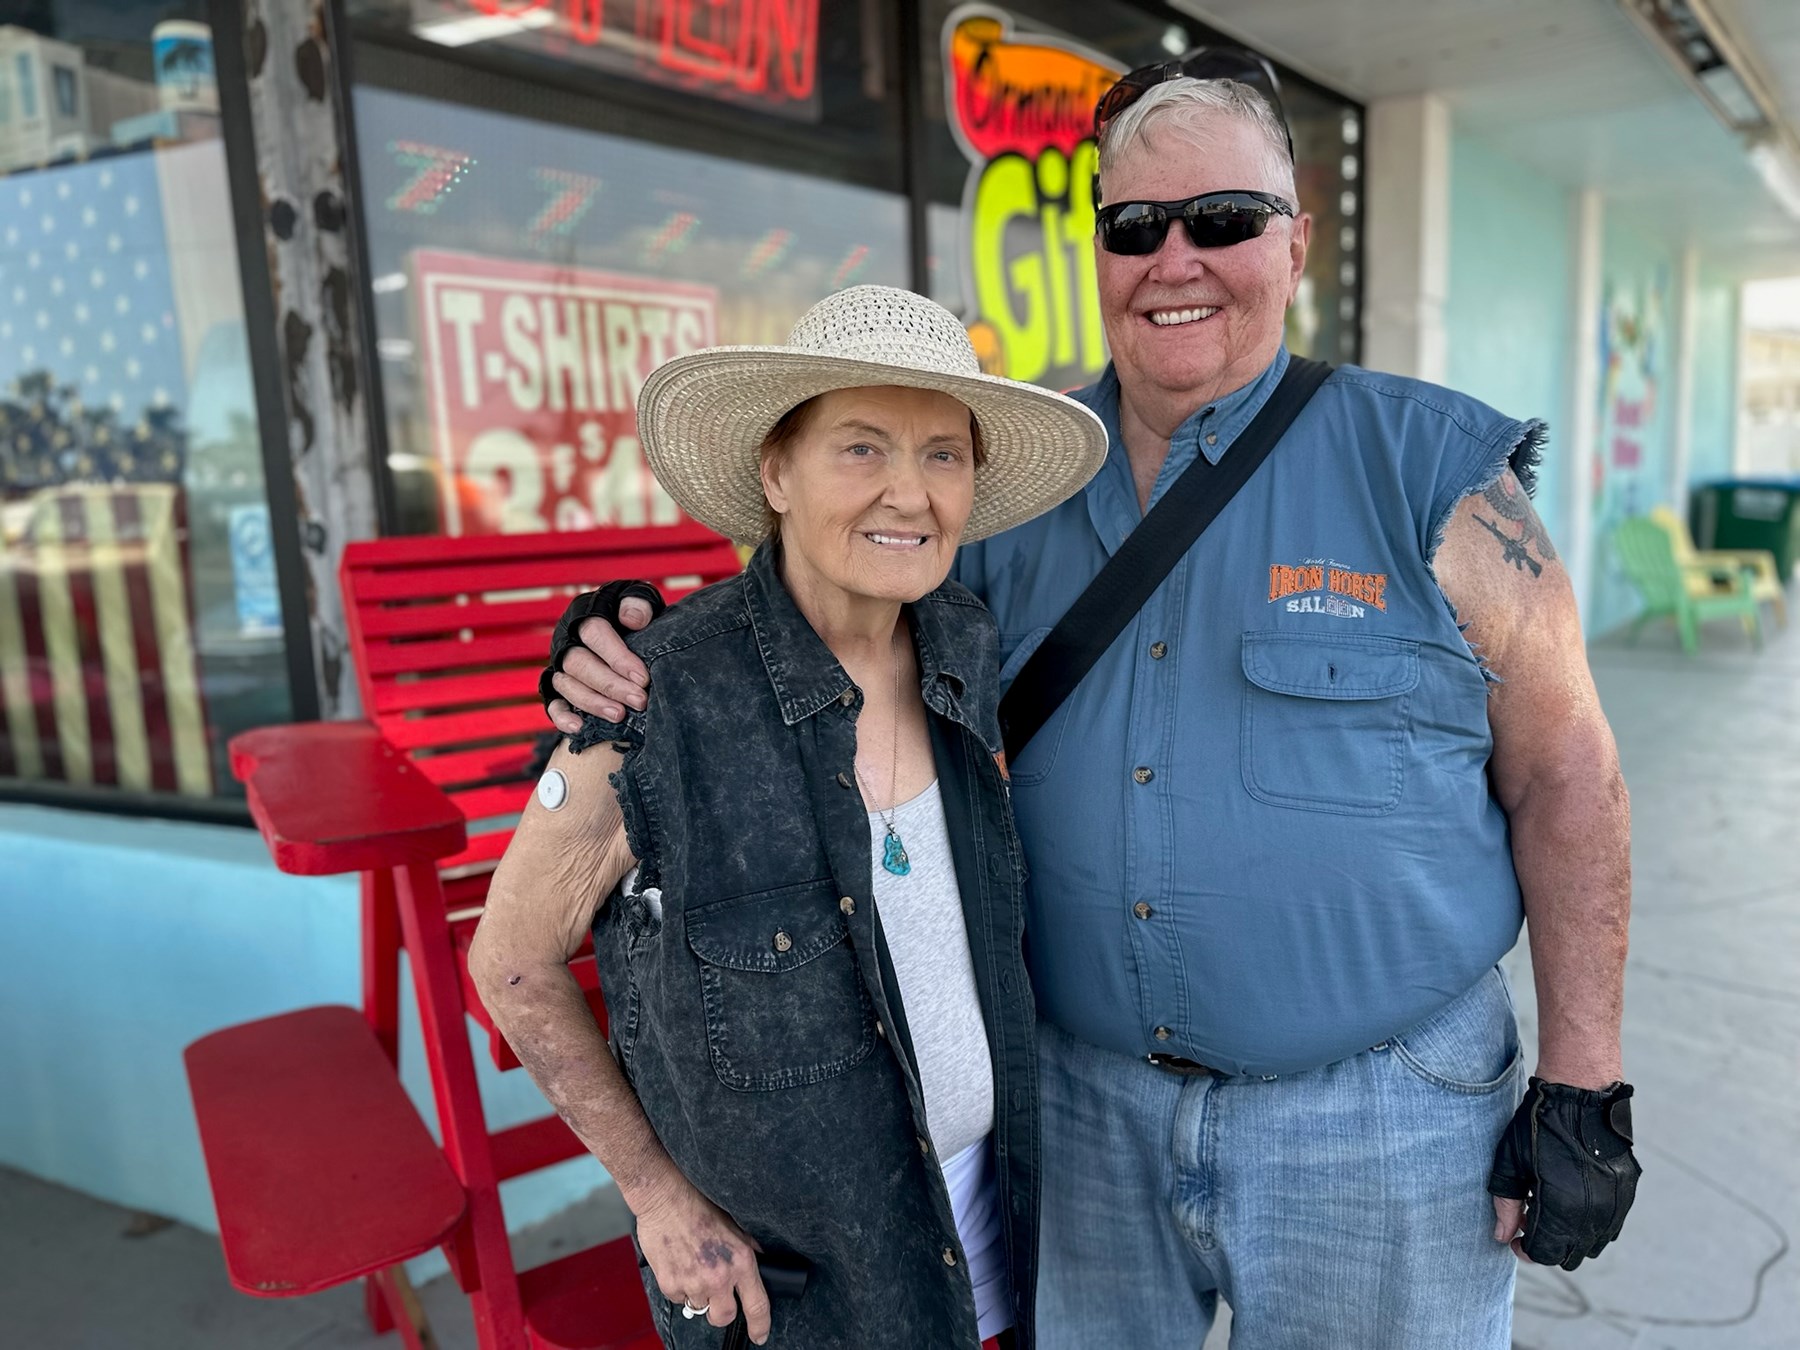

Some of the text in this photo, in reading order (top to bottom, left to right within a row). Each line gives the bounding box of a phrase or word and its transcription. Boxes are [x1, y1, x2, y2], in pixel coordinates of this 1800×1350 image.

[468, 0, 819, 98] EN
[1268, 563, 1387, 614] IRON HORSE
